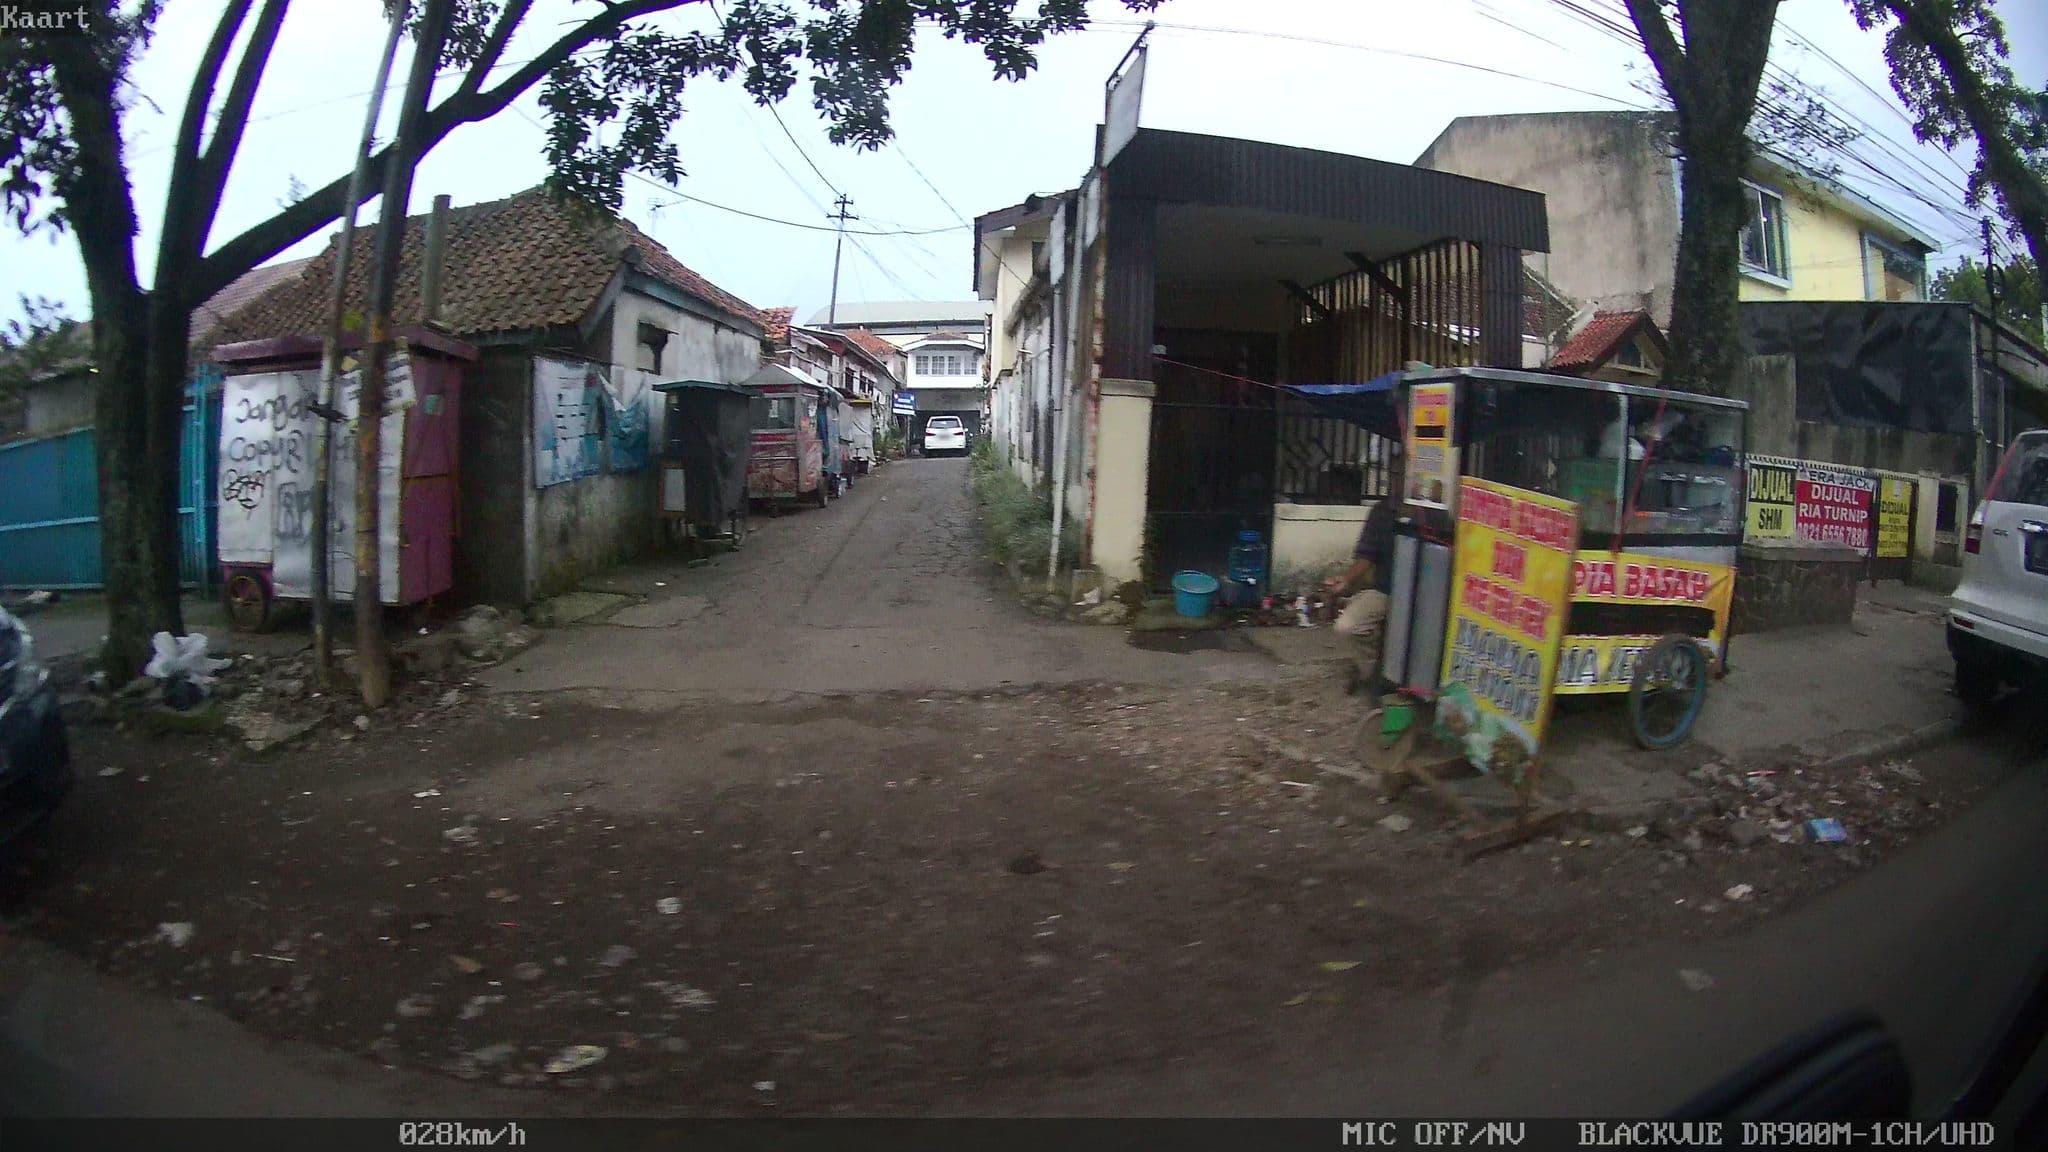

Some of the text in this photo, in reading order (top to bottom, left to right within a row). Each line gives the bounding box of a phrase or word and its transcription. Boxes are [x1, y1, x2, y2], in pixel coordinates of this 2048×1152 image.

[1749, 467, 1794, 502] DIJUAL
[1809, 469, 1836, 486] ERA
[1811, 484, 1860, 506] DIJUAL
[1759, 508, 1784, 530] SHM
[1799, 502, 1822, 519] RIA
[1823, 505, 1869, 524] TURNIP
